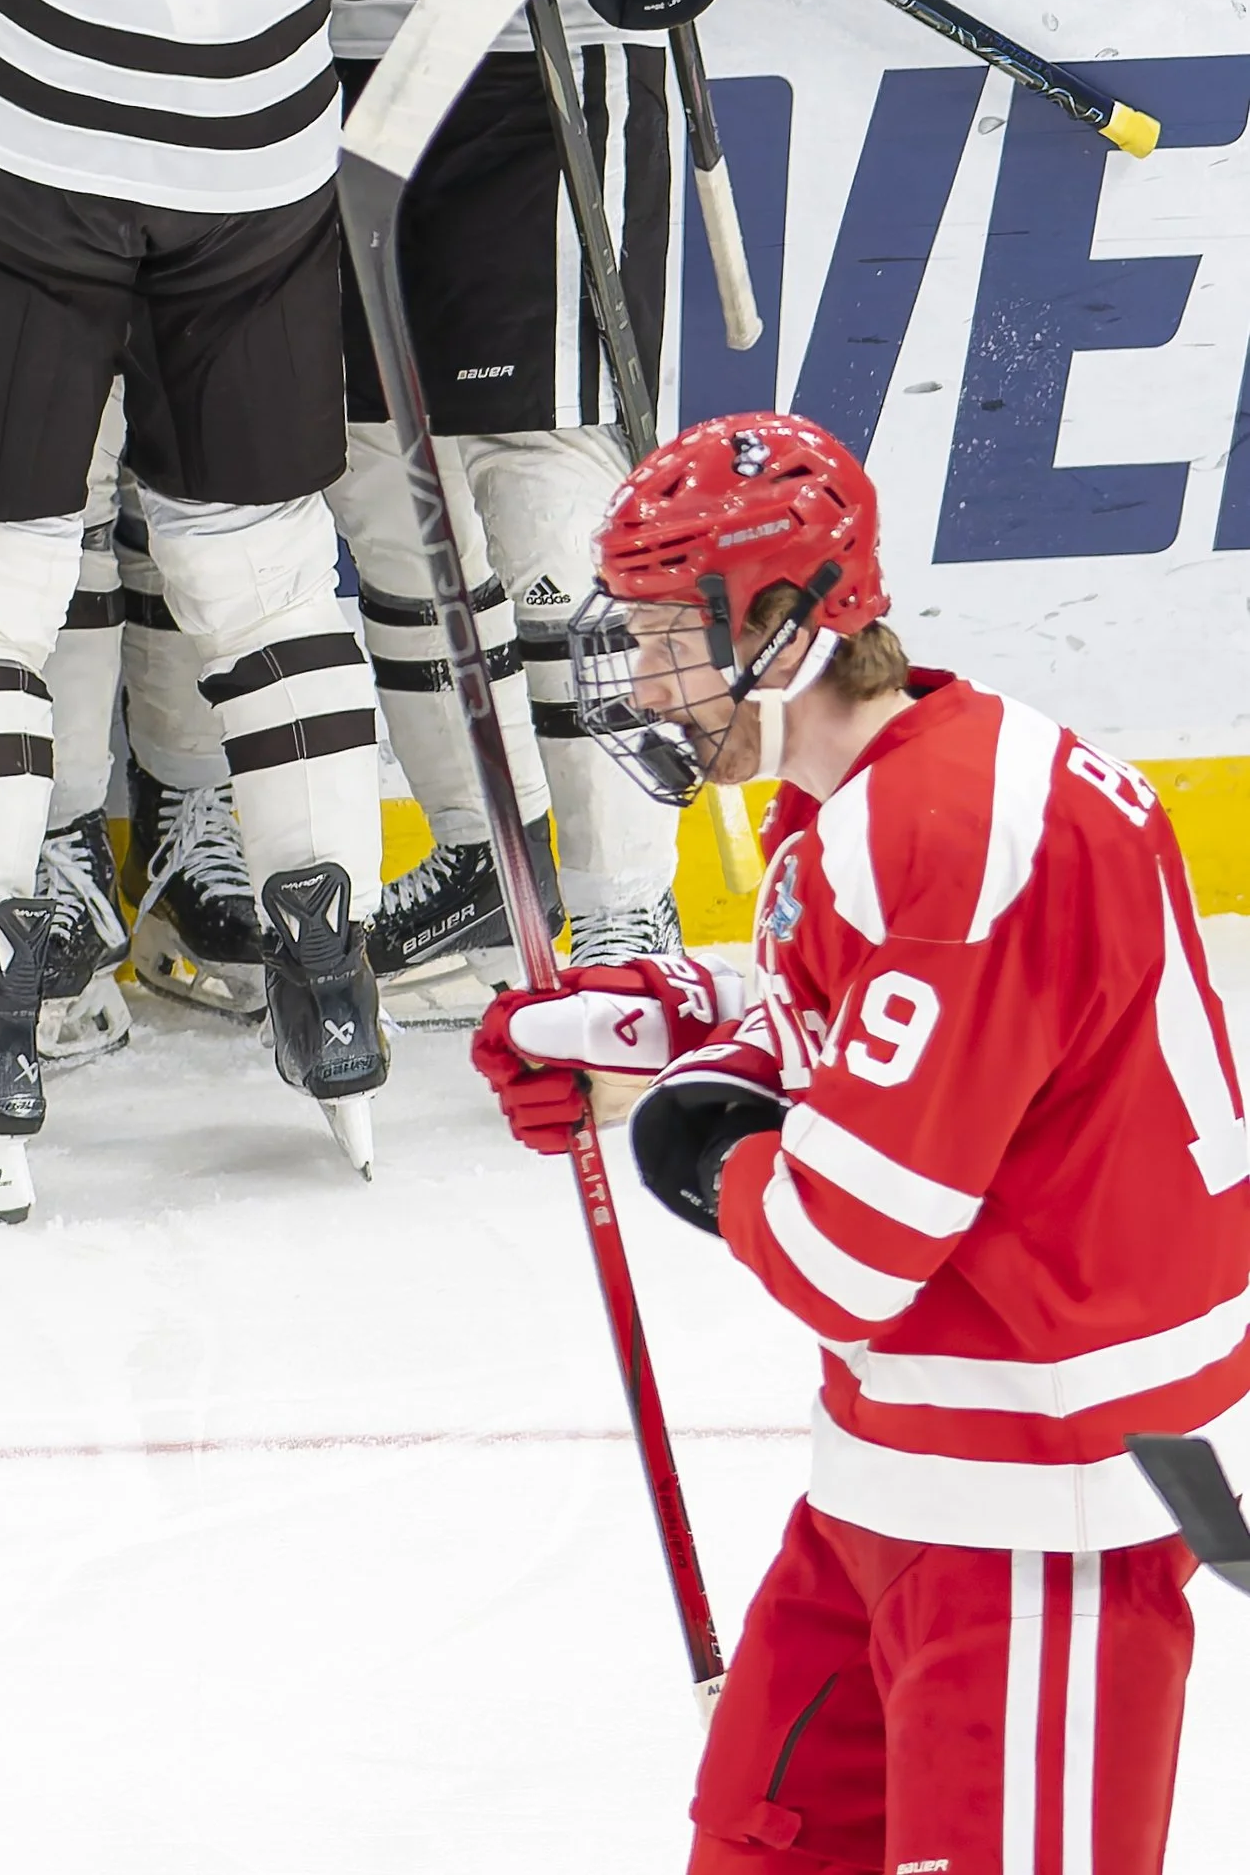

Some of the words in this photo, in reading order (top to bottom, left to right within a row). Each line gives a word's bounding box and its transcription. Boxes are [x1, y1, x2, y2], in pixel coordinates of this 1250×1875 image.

[456, 364, 515, 381] BAUER
[402, 428, 492, 722] VAPOR
[526, 592, 572, 607] adidas
[402, 902, 477, 956] BAUER
[896, 1858, 949, 1875] BAUER
